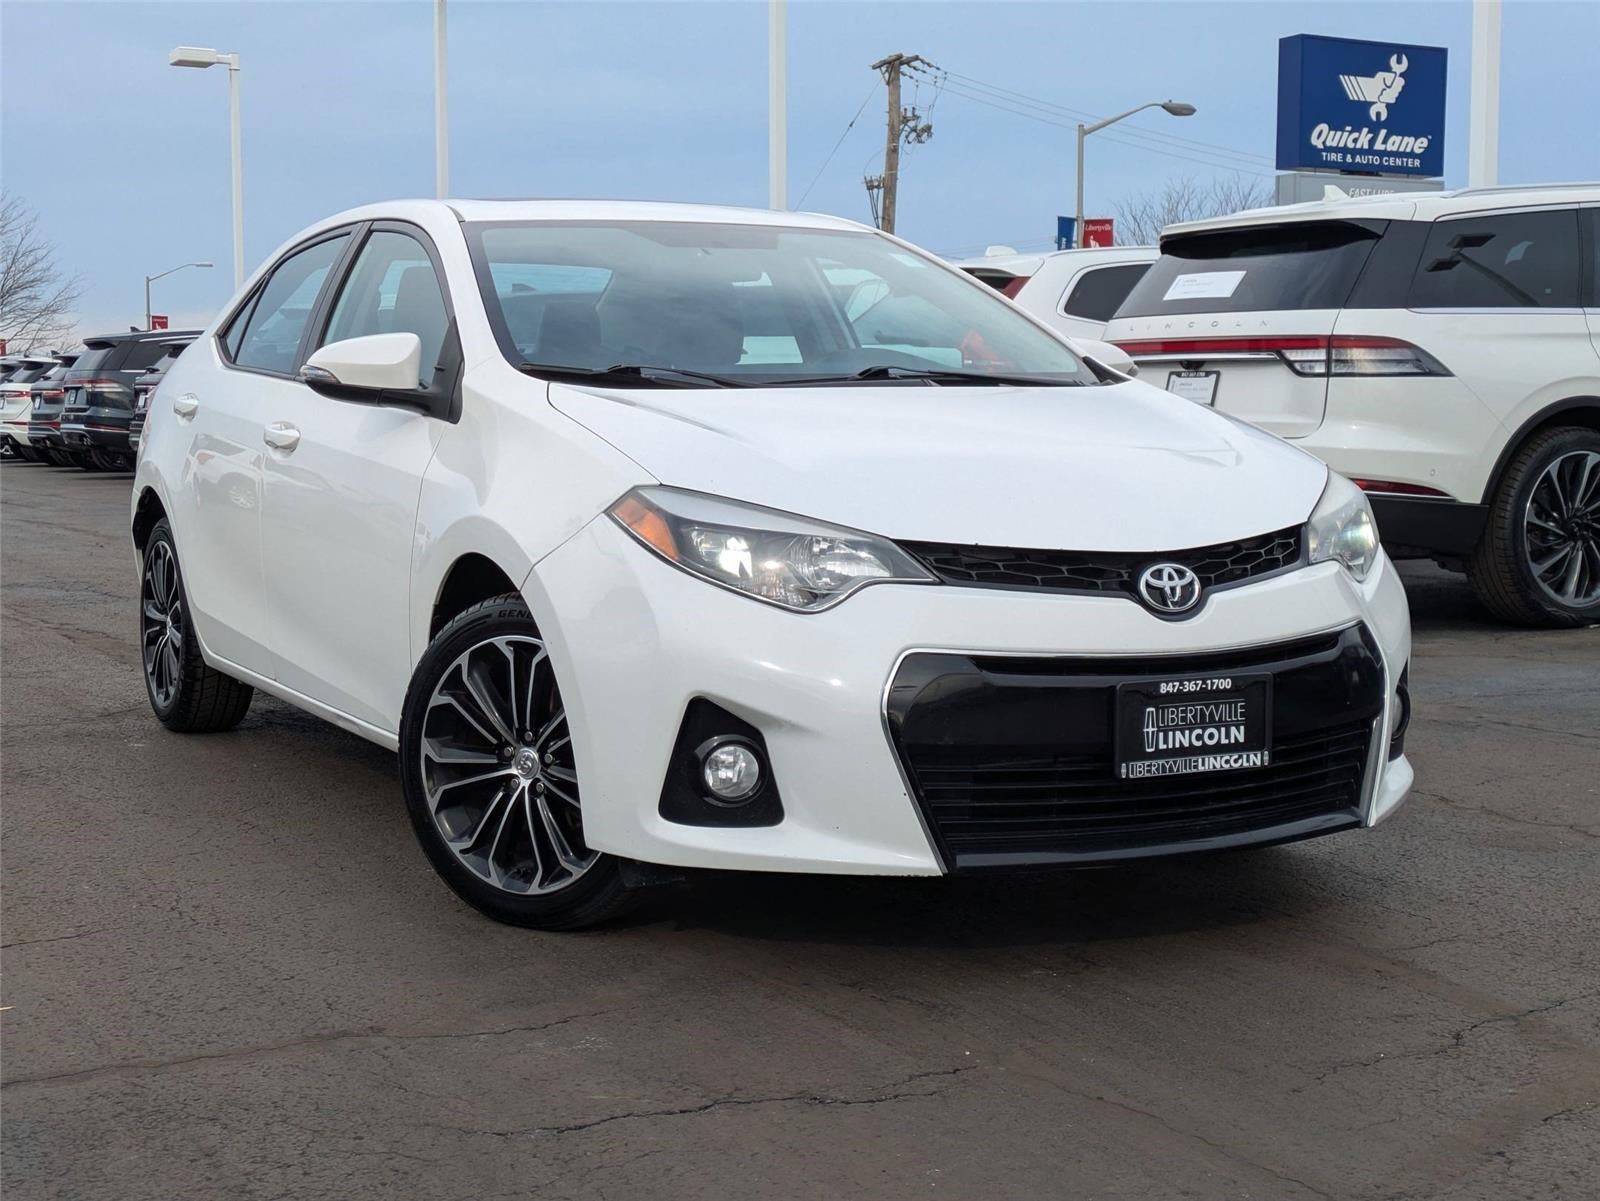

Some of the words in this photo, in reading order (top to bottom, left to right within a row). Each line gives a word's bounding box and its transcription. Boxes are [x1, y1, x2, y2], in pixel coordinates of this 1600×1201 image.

[1310, 122, 1373, 150] Quick
[1373, 128, 1429, 154] Lane
[1321, 151, 1343, 163] TIRE
[1346, 153, 1353, 163] &
[1355, 154, 1381, 165] AUTO
[1382, 156, 1421, 168] CENTER
[1129, 319, 1268, 332] LINCOLN
[1159, 678, 1232, 694] 847-367-1700
[1158, 702, 1246, 727] LIBERTYVILLE
[1158, 725, 1245, 750] LINCOLN
